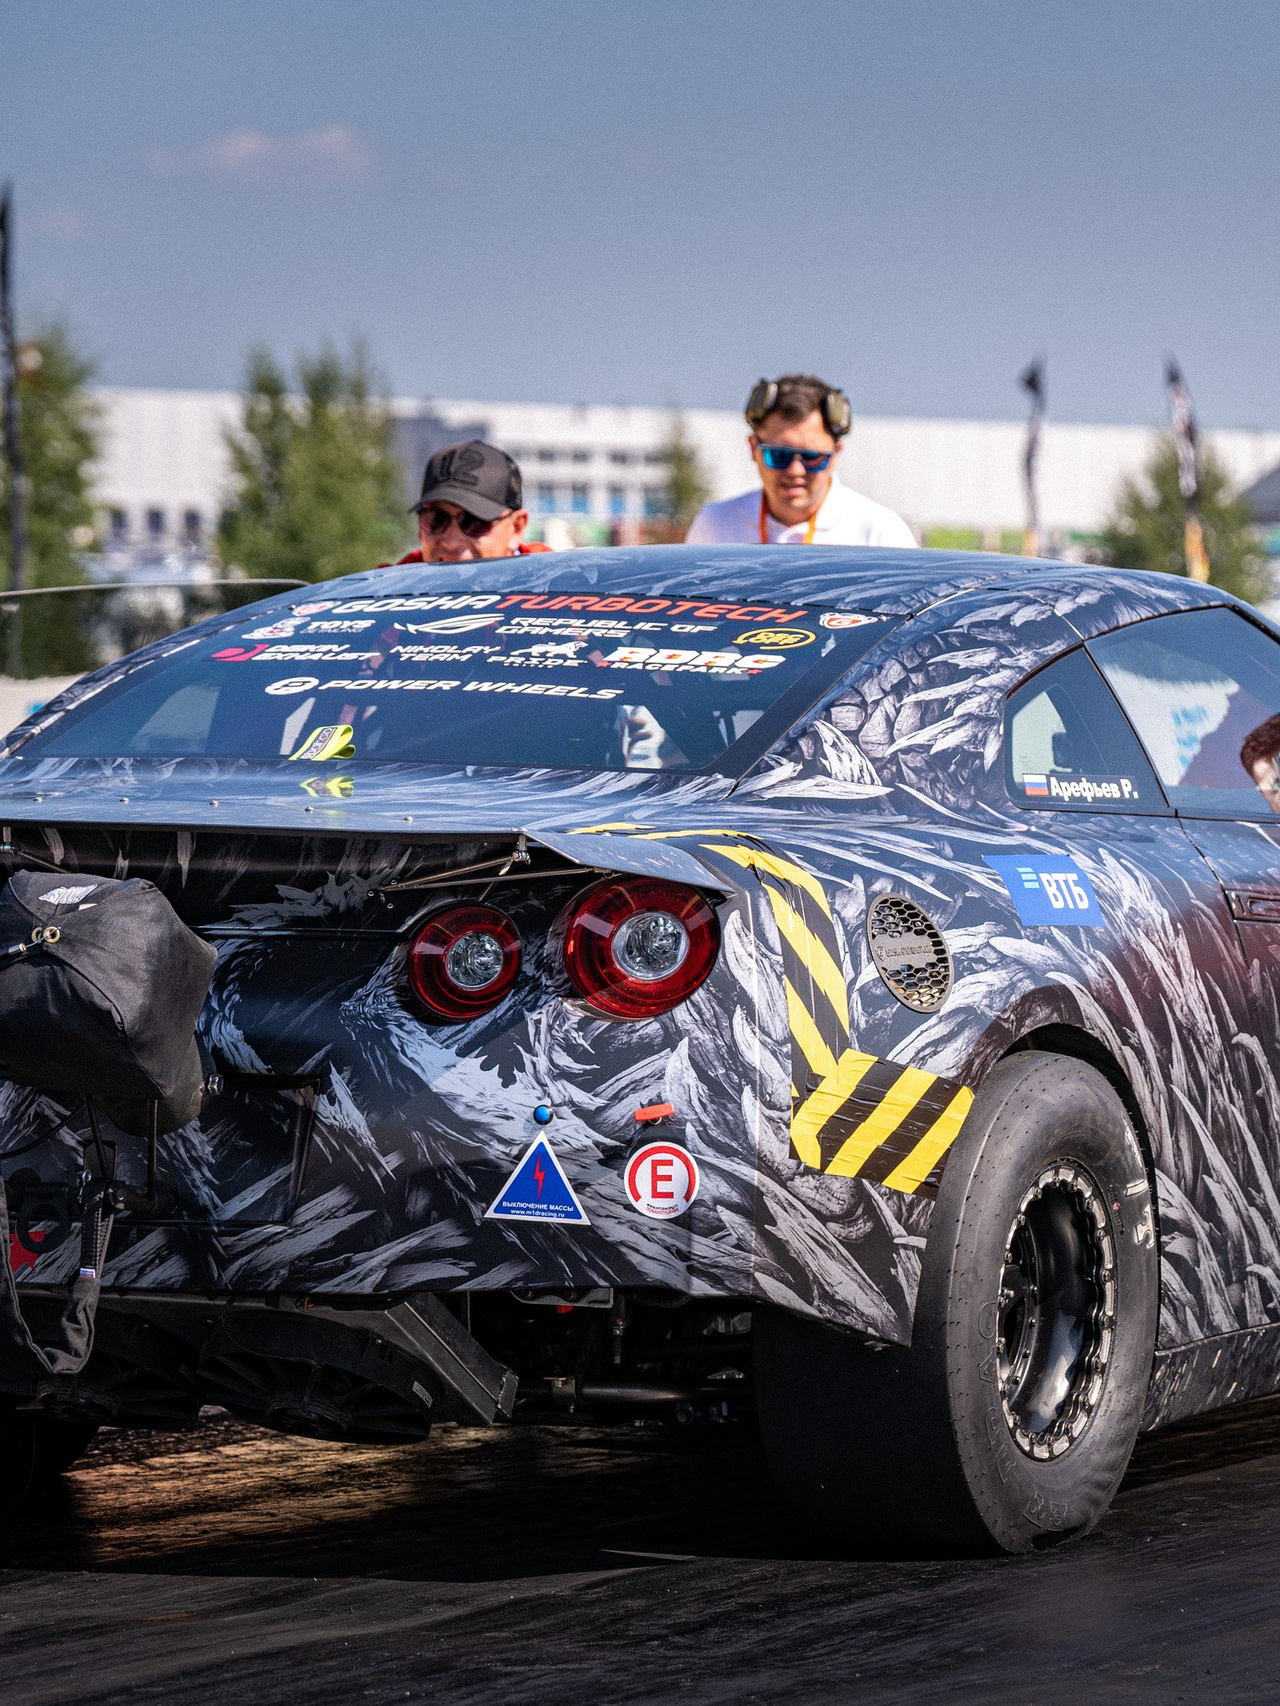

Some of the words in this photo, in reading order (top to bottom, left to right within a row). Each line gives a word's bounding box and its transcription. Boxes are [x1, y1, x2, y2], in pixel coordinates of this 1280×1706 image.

[332, 594, 501, 614] GOSHA
[495, 594, 808, 623] TURBOTECH
[307, 619, 376, 630] TOYS
[511, 617, 669, 631] REPUBLIC
[670, 624, 718, 633] OF
[495, 626, 631, 638] GAMERS
[748, 636, 801, 645] OFF
[390, 645, 501, 654] NIKOLAY
[252, 653, 380, 661] EXHAUST
[400, 653, 472, 662] TEAM
[487, 655, 586, 667] PRIDE
[610, 662, 748, 675] RACEPARK
[318, 680, 461, 691] POWER
[463, 681, 624, 700] WHEELS
[1050, 777, 1121, 802] Арефьев
[1120, 778, 1139, 799] Р.
[1039, 872, 1089, 910] ВТБ
[651, 1159, 674, 1199] E
[502, 1200, 548, 1210] ВЫКЛЮЧЕНИЕ
[549, 1204, 574, 1212] МАССЫ
[510, 1209, 566, 1218] www.m1dracing.ru
